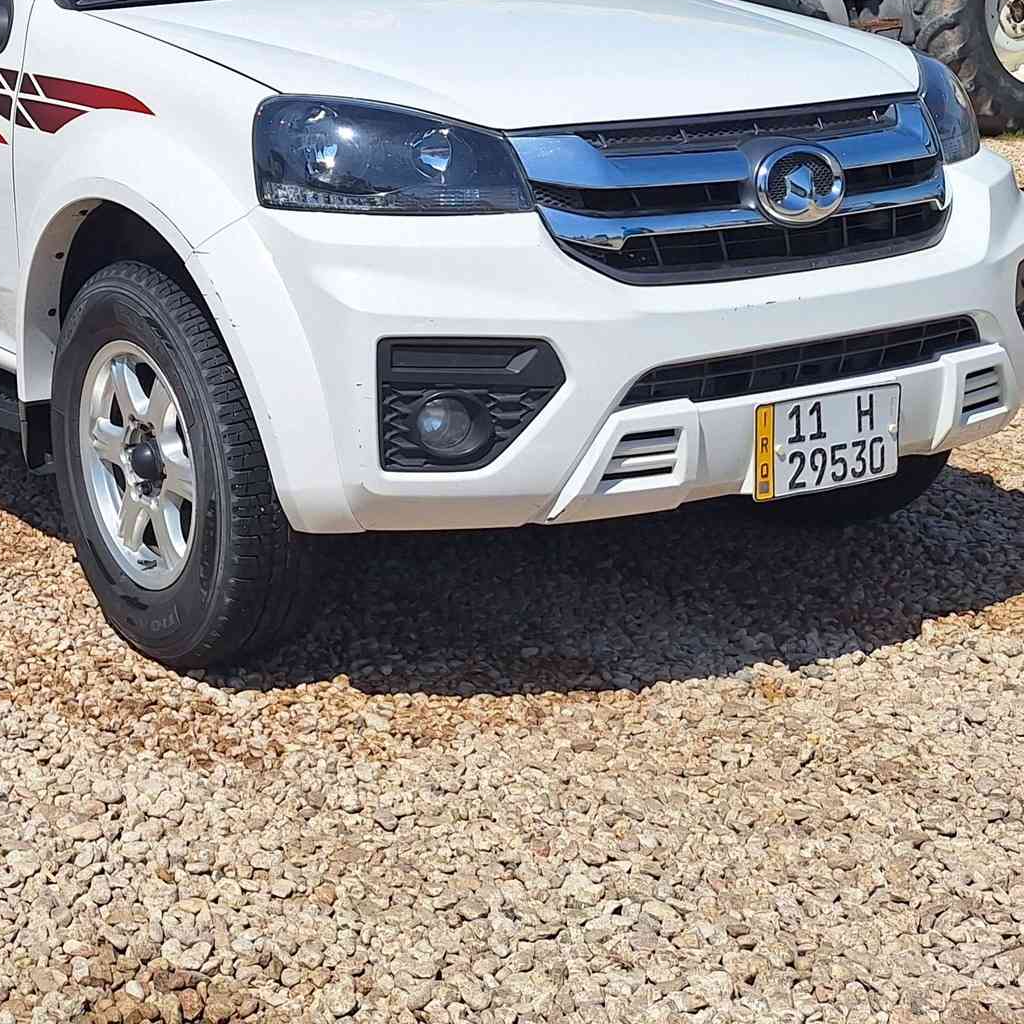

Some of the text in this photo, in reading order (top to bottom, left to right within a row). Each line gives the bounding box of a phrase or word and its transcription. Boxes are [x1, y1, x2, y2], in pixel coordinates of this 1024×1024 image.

[787, 393, 875, 444] 11 H
[788, 436, 886, 490] 29530
